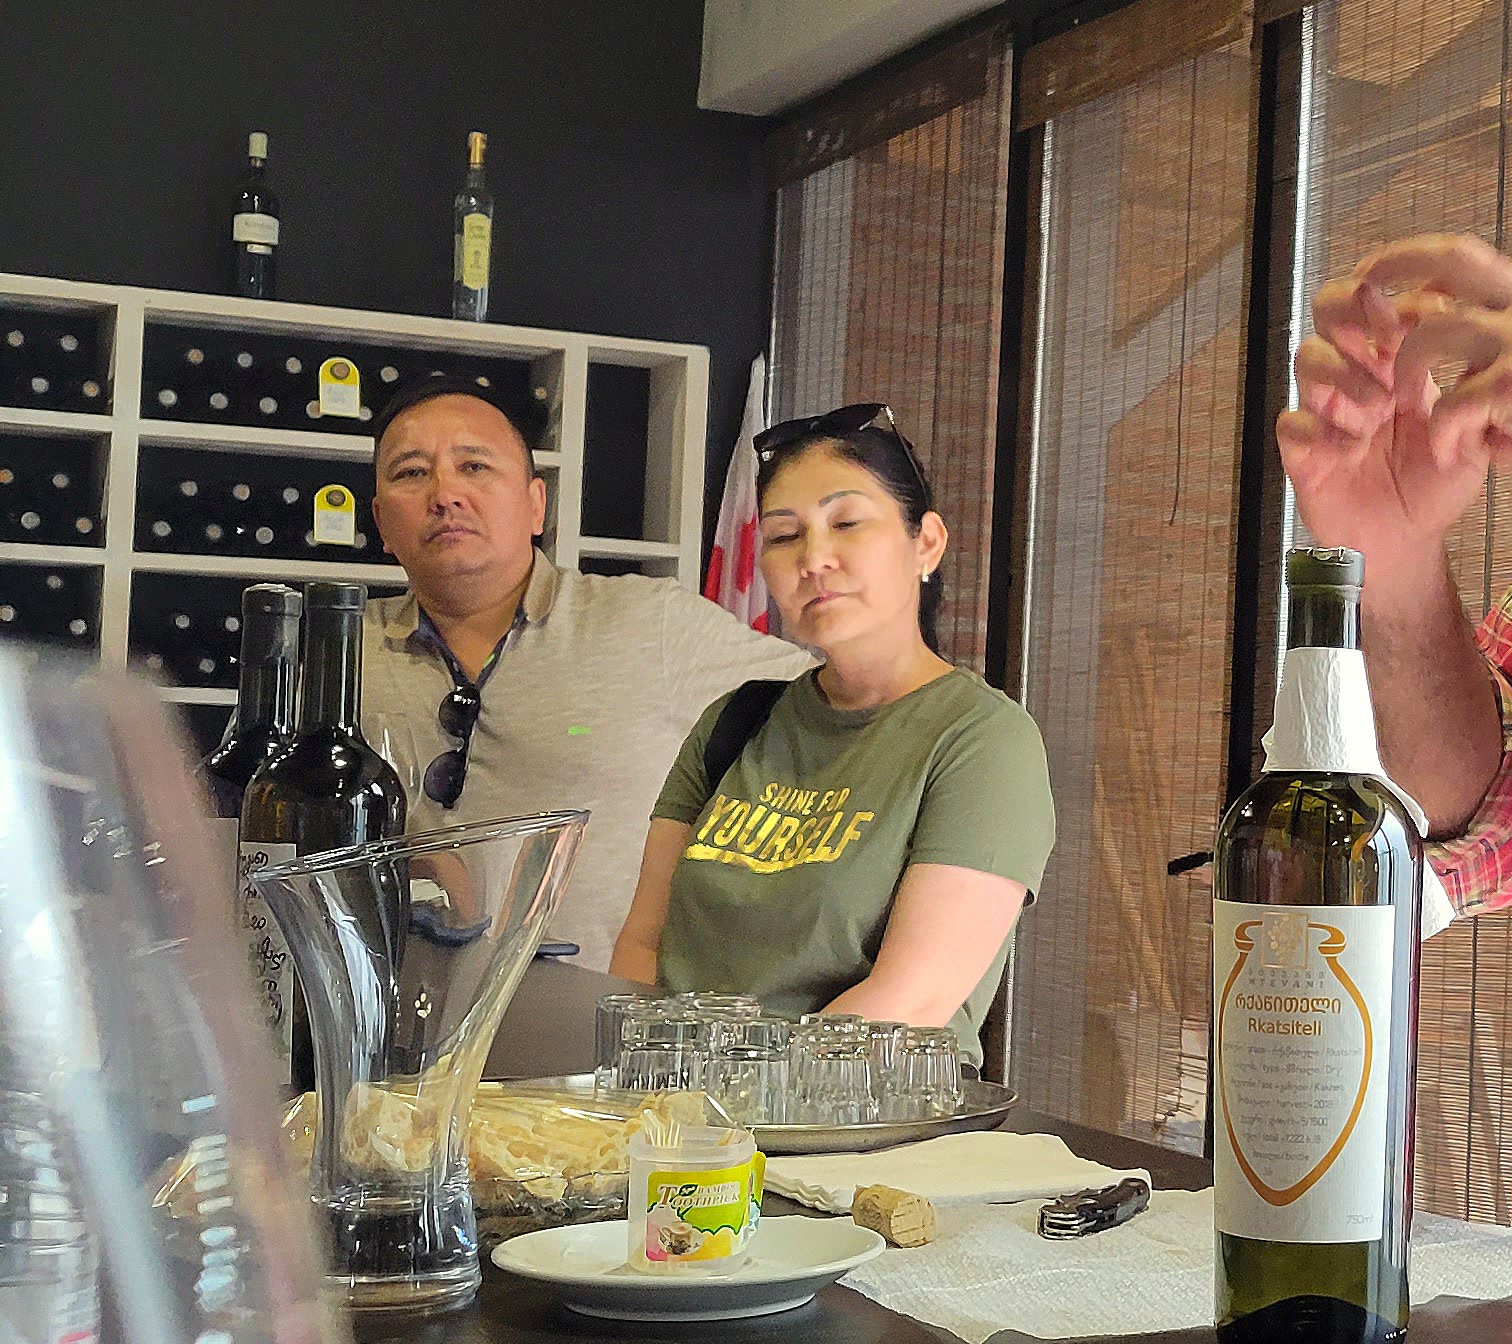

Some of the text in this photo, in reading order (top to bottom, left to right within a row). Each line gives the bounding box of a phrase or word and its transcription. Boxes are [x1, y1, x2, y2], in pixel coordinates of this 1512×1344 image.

[759, 782, 819, 816] SHINE
[697, 794, 875, 862] YOURSELF
[1248, 978, 1324, 989] MTEVANI
[1248, 1017, 1322, 1036] Rkatsiteli
[660, 1186, 738, 1206] TOOTHPICK
